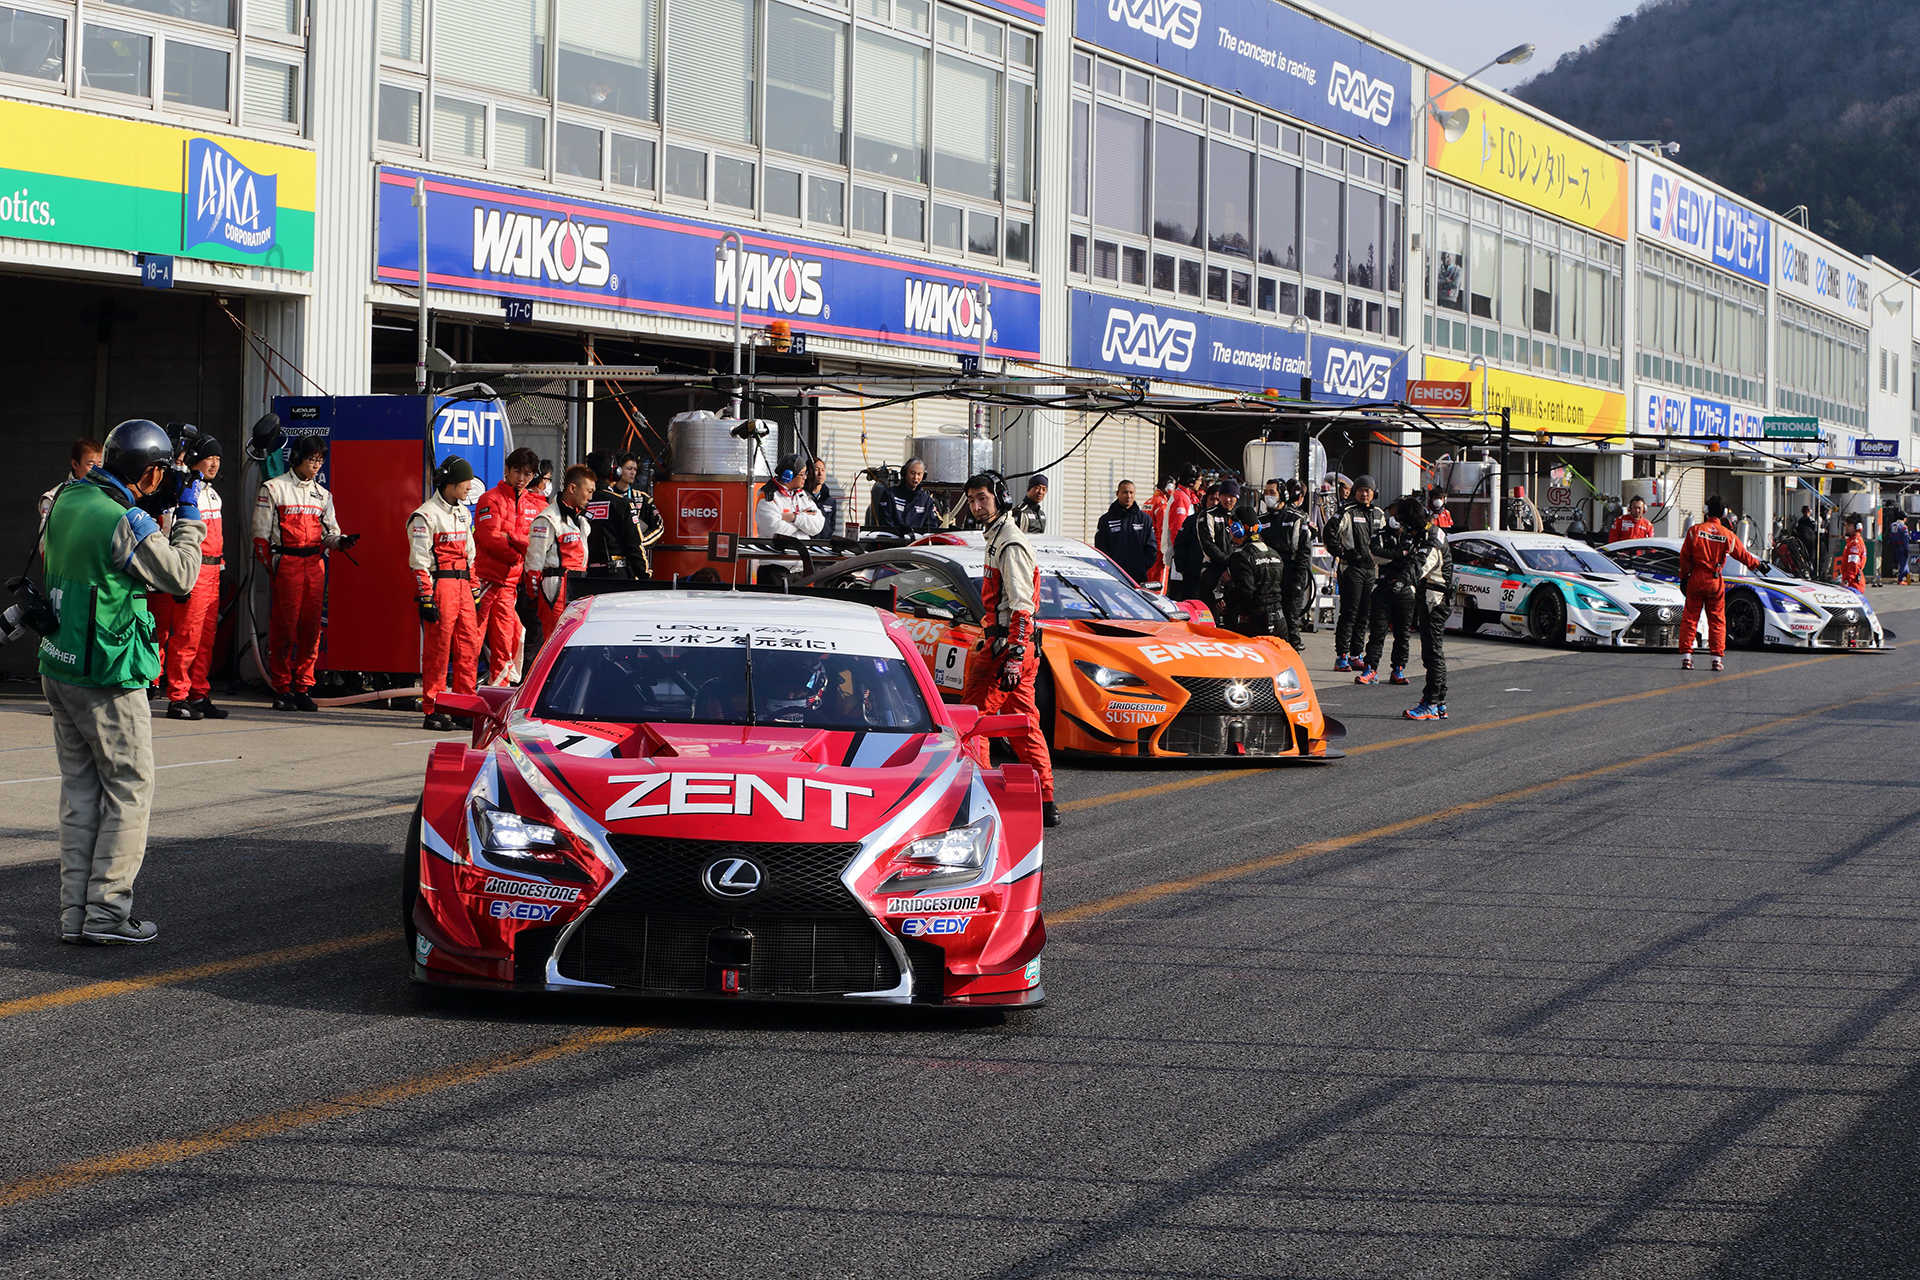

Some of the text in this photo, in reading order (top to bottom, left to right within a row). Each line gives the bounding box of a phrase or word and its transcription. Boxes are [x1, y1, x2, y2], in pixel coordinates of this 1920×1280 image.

[1218, 27, 1317, 87] The concept is racing.
[1328, 60, 1395, 127] RAYS
[197, 147, 261, 239] ASKA
[1650, 172, 1713, 251] EXEDY
[225, 221, 271, 247] CORPORATION
[1715, 204, 1765, 276] エクセディ
[472, 207, 612, 287] WAKO'S
[146, 262, 170, 282] 18-A
[714, 248, 824, 317] WAKO'S
[508, 302, 531, 320] 17-C
[1101, 307, 1196, 373] RAYS
[1213, 341, 1312, 376] The concept is racin.
[1324, 347, 1393, 400] RAYS
[1413, 387, 1463, 401] ENEOS
[1648, 395, 1687, 433] EXEDY
[438, 409, 502, 447] ZENT
[1765, 421, 1817, 432] PETRONAS
[1860, 441, 1894, 453] KeePer
[681, 507, 718, 518] ENEOS
[1458, 583, 1491, 594] PETRONAS
[1501, 589, 1516, 602] 36
[656, 624, 739, 632] LEXUS
[945, 646, 958, 669] 6
[1138, 641, 1266, 665] ENEOS
[1107, 700, 1167, 712] BRIDGESTONE
[1105, 711, 1158, 726] SUSTINA
[554, 735, 589, 751] 1
[605, 771, 875, 831] ZENT
[484, 877, 581, 902] BRIDGESTONE
[490, 901, 561, 921] EXEDY
[886, 896, 980, 913] BRIDGESTONE
[901, 916, 973, 937] EXEDY
